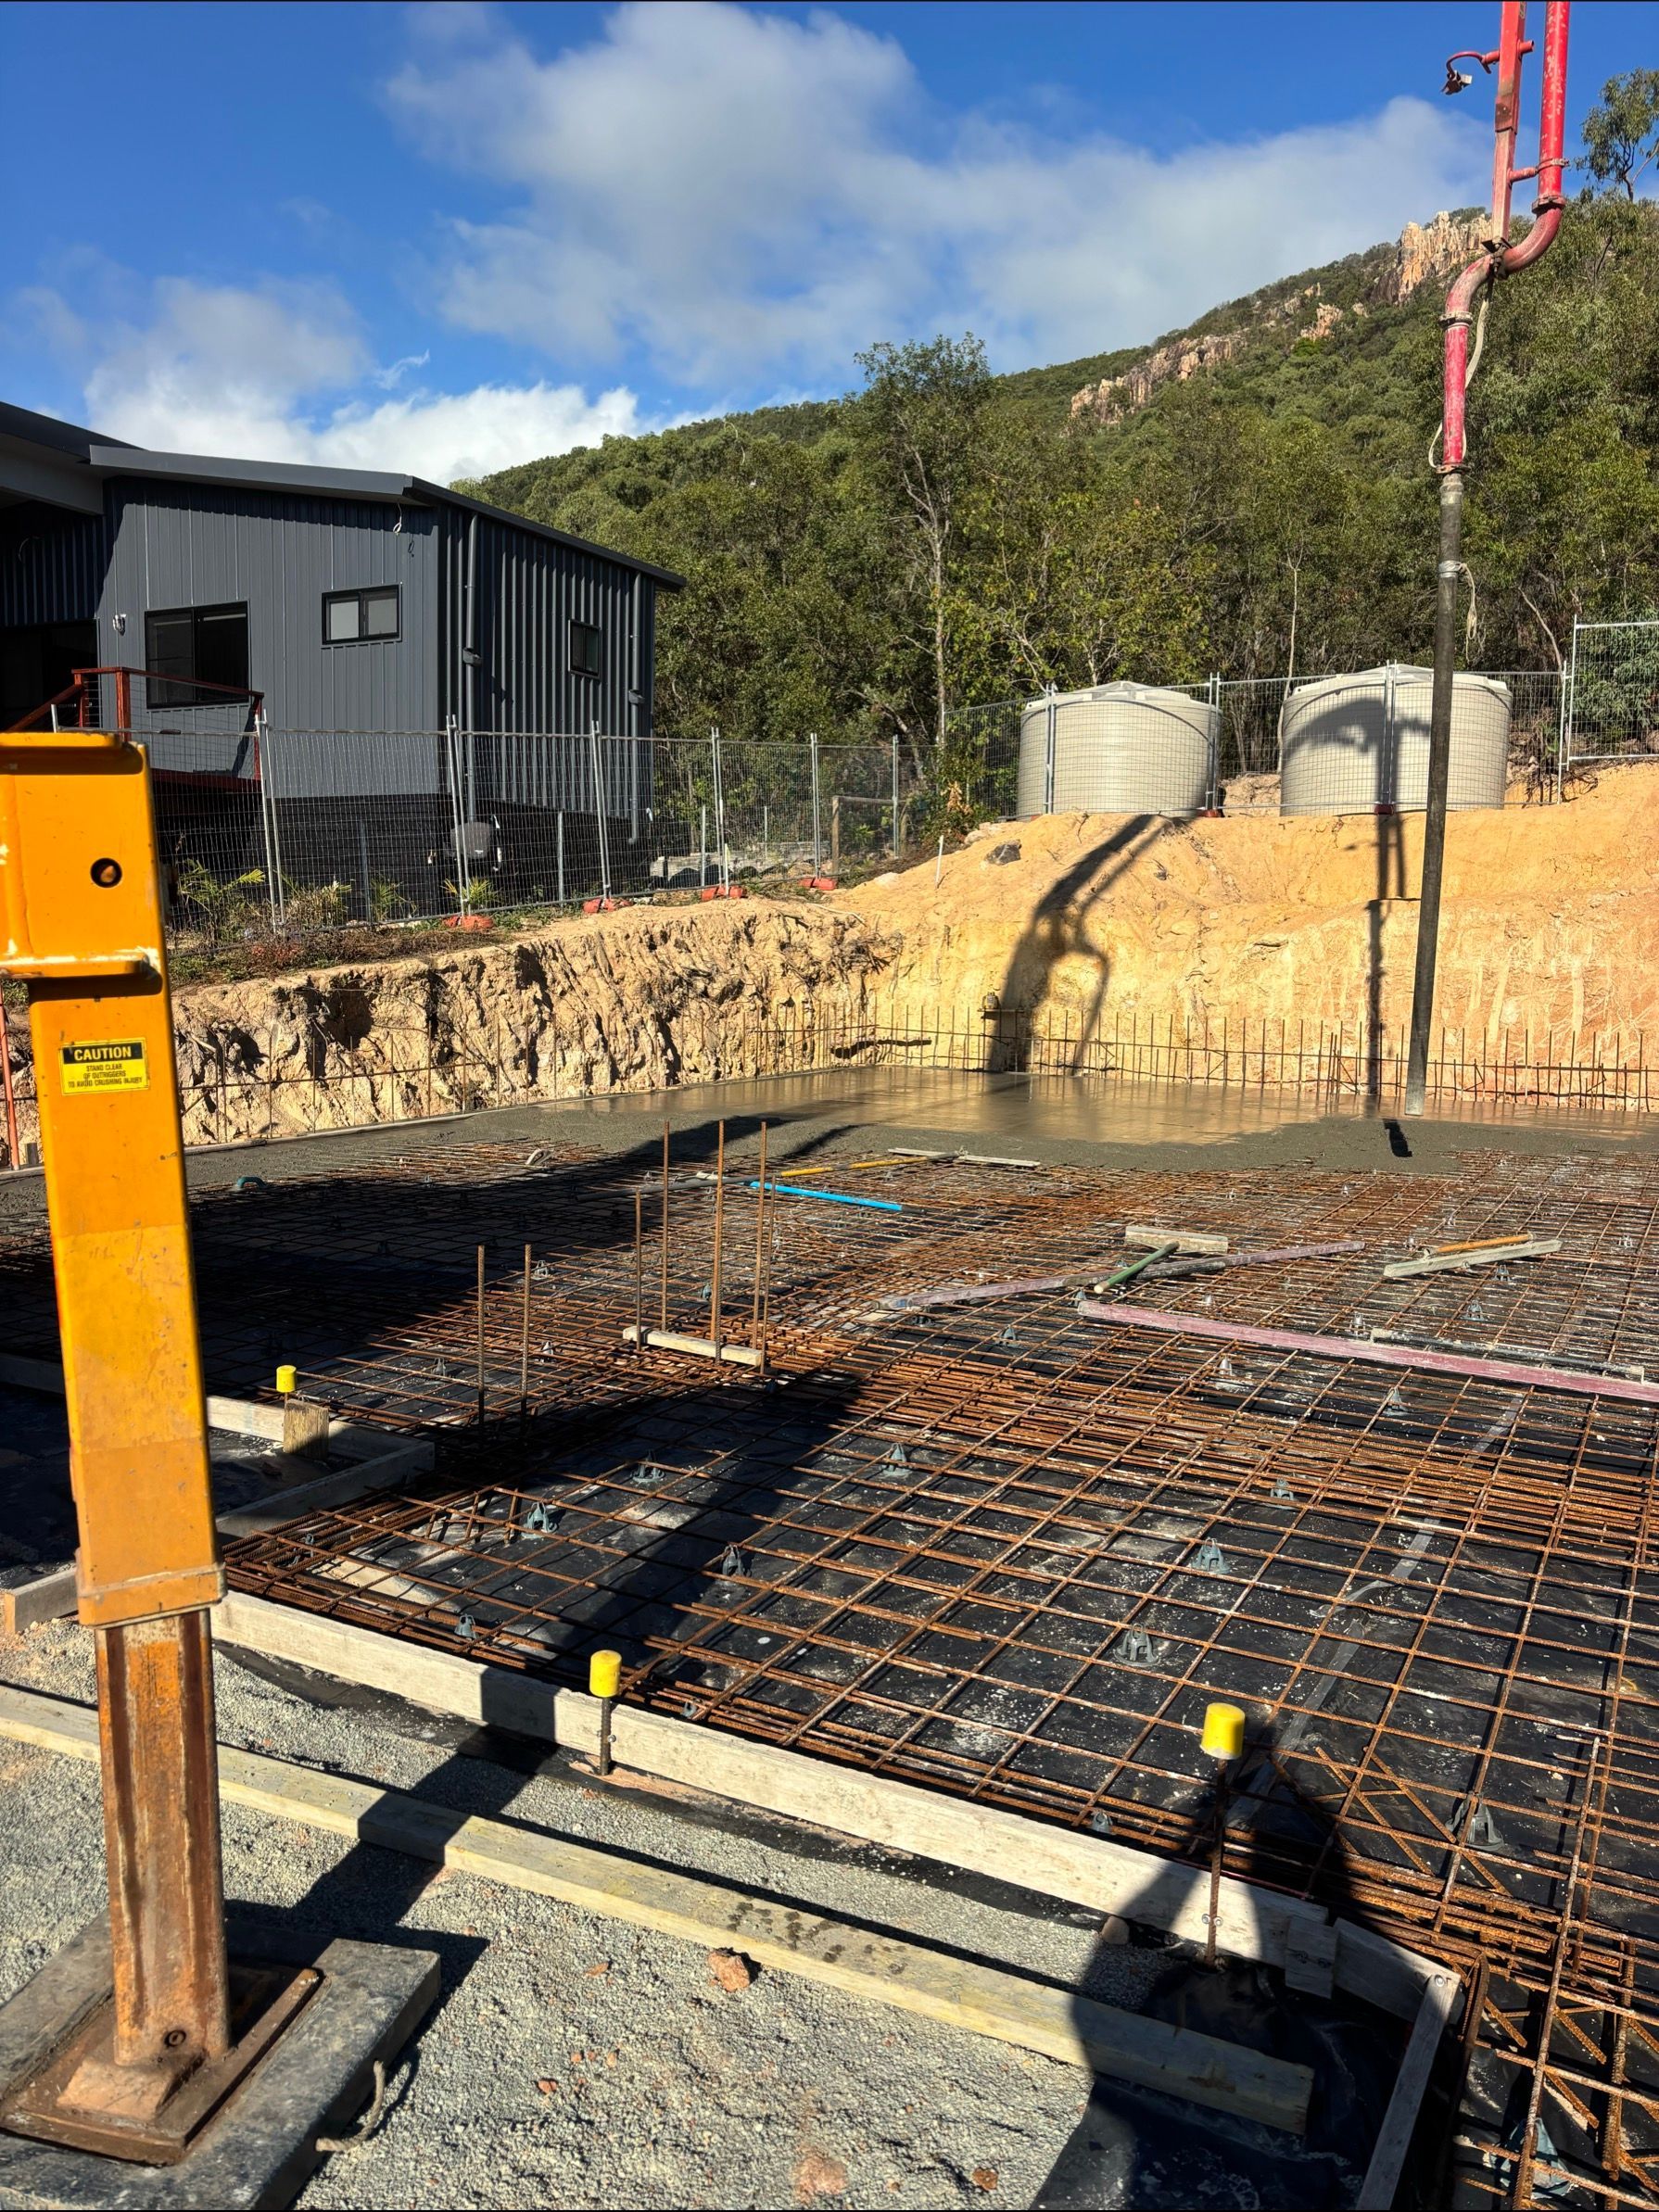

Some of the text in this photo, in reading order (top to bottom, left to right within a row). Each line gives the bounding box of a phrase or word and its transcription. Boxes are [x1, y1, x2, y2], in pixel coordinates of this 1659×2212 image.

[74, 1046, 132, 1061] CAUTION
[92, 1070, 126, 1079] OUTRIGGERS
[95, 1078, 121, 1086] CRUSHING
